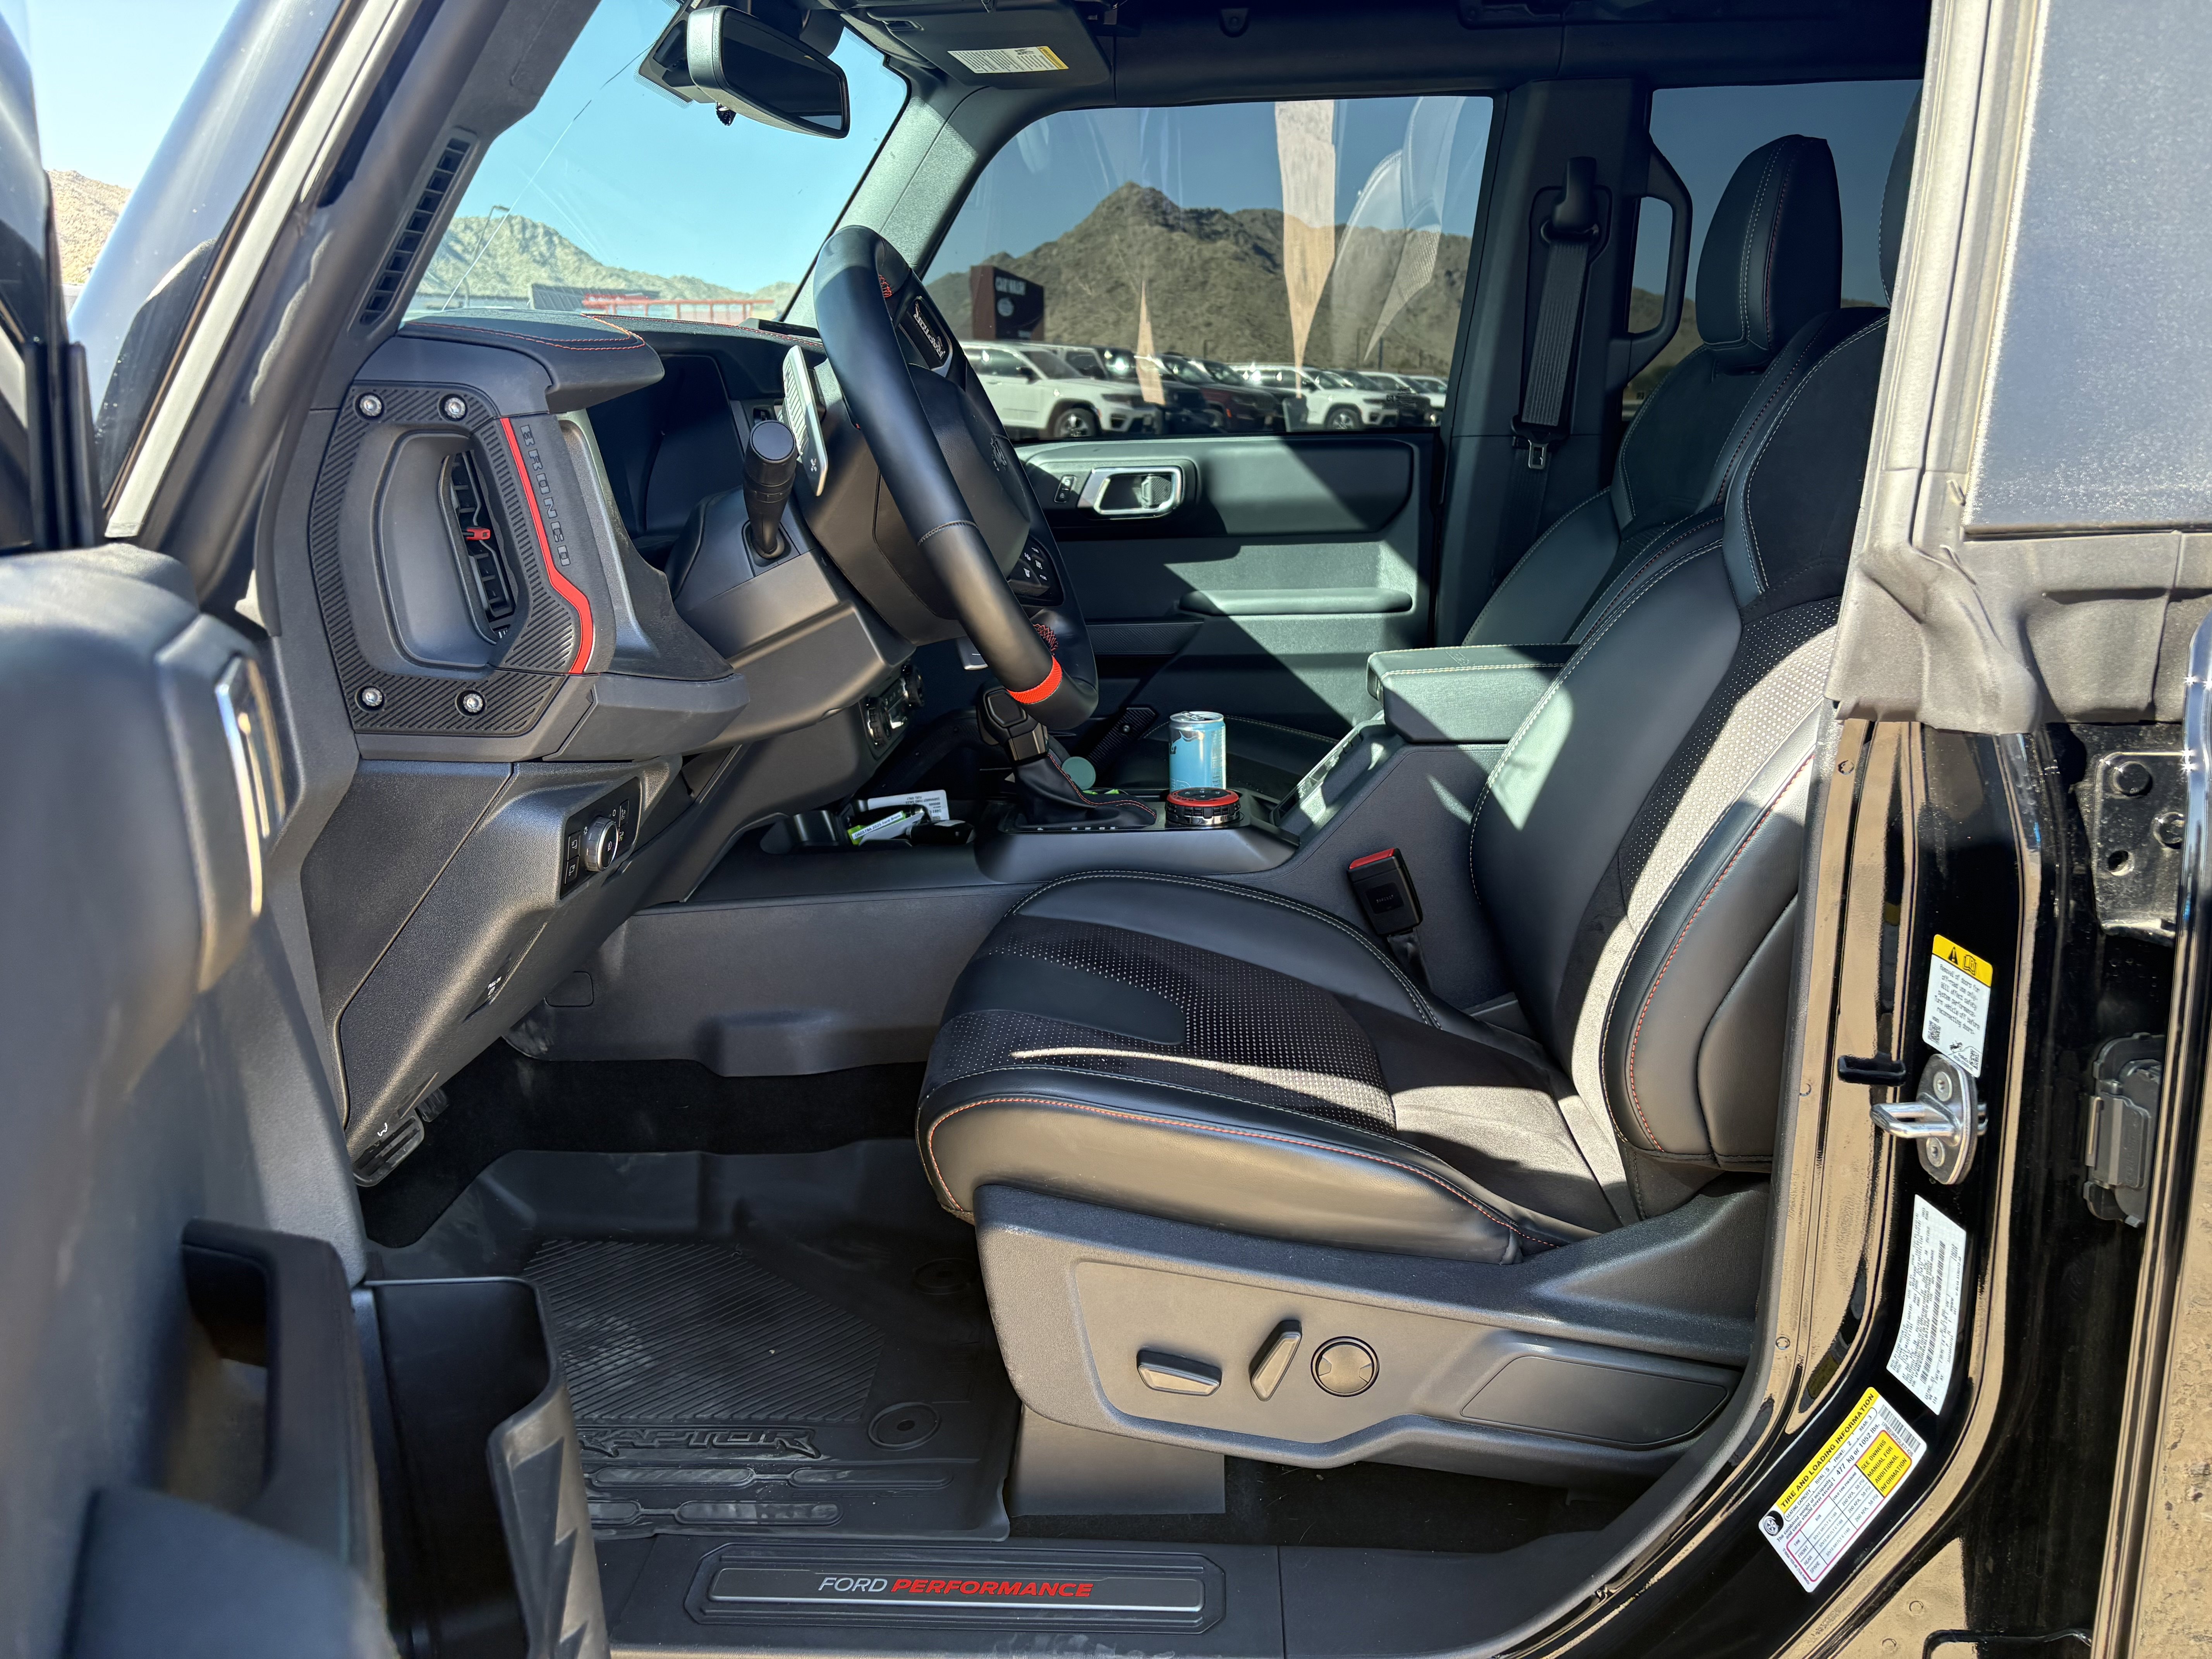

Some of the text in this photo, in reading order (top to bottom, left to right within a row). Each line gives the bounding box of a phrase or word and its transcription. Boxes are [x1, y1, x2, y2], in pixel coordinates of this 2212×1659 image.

[913, 301, 946, 360] RAPTOR
[520, 424, 570, 566] BRONCO
[1941, 974, 1959, 990] off-road
[1954, 972, 1960, 981] of
[1961, 976, 1972, 989] doors
[1934, 994, 1943, 1006] Turn
[1944, 1001, 1958, 1016] vehicle
[1967, 1016, 1980, 1030] before
[1937, 990, 1950, 1004] system
[1950, 987, 1963, 1001] affect
[1964, 996, 1977, 1011] safety
[579, 1429, 821, 1459] RAPTOR
[1781, 1393, 1874, 1509] TIRE AND LOADING INFORMATION
[1835, 1421, 1880, 1476] 477 kg or 1052 lbs.
[1860, 1439, 1887, 1471] SEE OWNERS
[1867, 1445, 1893, 1478] MANUAL FOR
[1874, 1453, 1899, 1484] ADDITIONAL
[1879, 1457, 1908, 1492] INFORMATION
[1783, 1515, 1800, 1535] combined
[1798, 1502, 1811, 1518] weight
[1814, 1478, 1831, 1499] occupants
[1786, 1488, 1811, 1519] SEATING CAPACITY
[1792, 1519, 1802, 1532] cargo
[1801, 1506, 1813, 1521] should
[1812, 1496, 1822, 1508] never
[1821, 1481, 1834, 1497] exceed
[1798, 1545, 1808, 1559] FRONT
[1803, 1554, 1813, 1566] REAR
[1809, 1560, 1820, 1574] SPARE
[818, 1577, 1093, 1597] FORD PERFORMANCE
